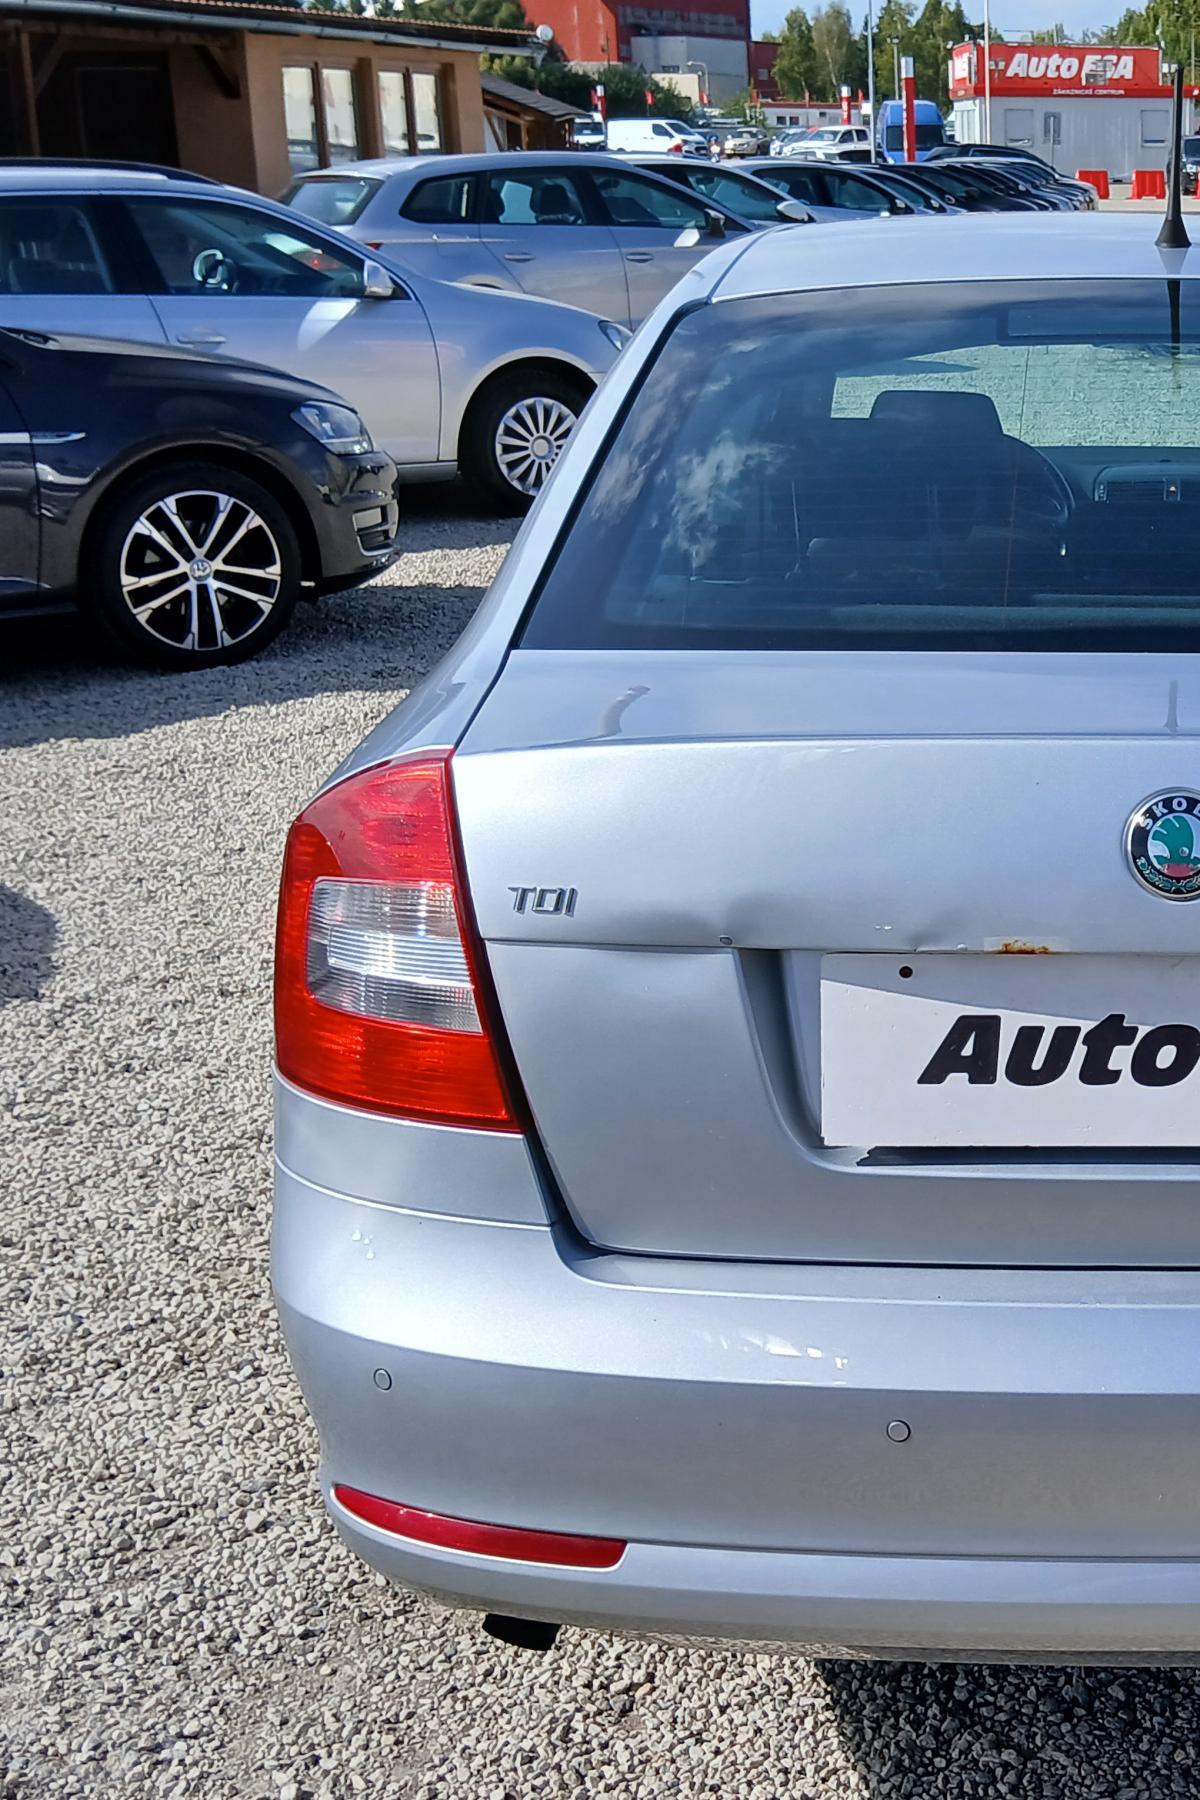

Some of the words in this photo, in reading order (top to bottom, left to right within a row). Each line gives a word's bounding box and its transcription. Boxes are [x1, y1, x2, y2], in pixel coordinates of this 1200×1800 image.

[1005, 52, 1080, 79] Auto
[1081, 54, 1134, 80] ESA
[506, 885, 579, 918] TDI
